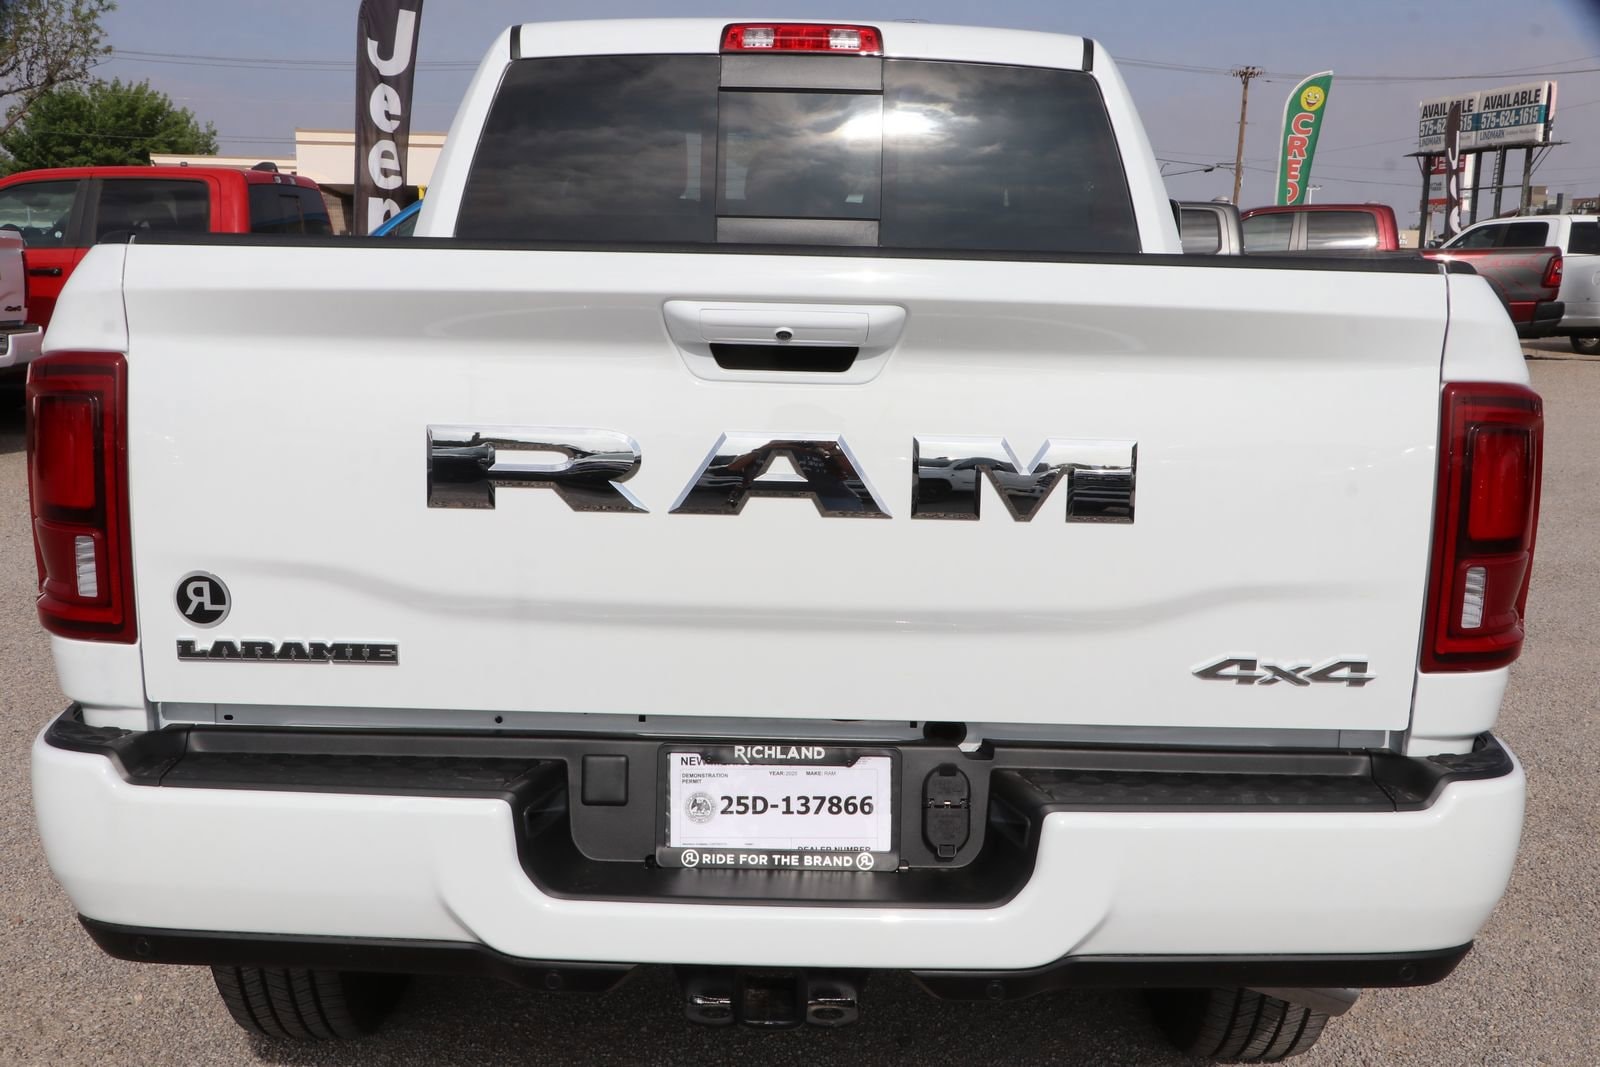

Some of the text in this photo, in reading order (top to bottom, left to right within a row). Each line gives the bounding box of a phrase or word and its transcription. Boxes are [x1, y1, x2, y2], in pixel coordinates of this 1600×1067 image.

[1422, 99, 1474, 119] AVAILALE
[1483, 89, 1541, 111] AVAILABLE
[1420, 115, 1472, 136] 575-62615
[1481, 107, 1538, 129] 575-624-1615
[426, 424, 1138, 524] RAM
[176, 638, 400, 666] LARAMIE
[734, 745, 826, 763] RICHLAND
[720, 795, 874, 816] 25D-137866
[702, 854, 853, 867] RIDE FOR THE BRAND
